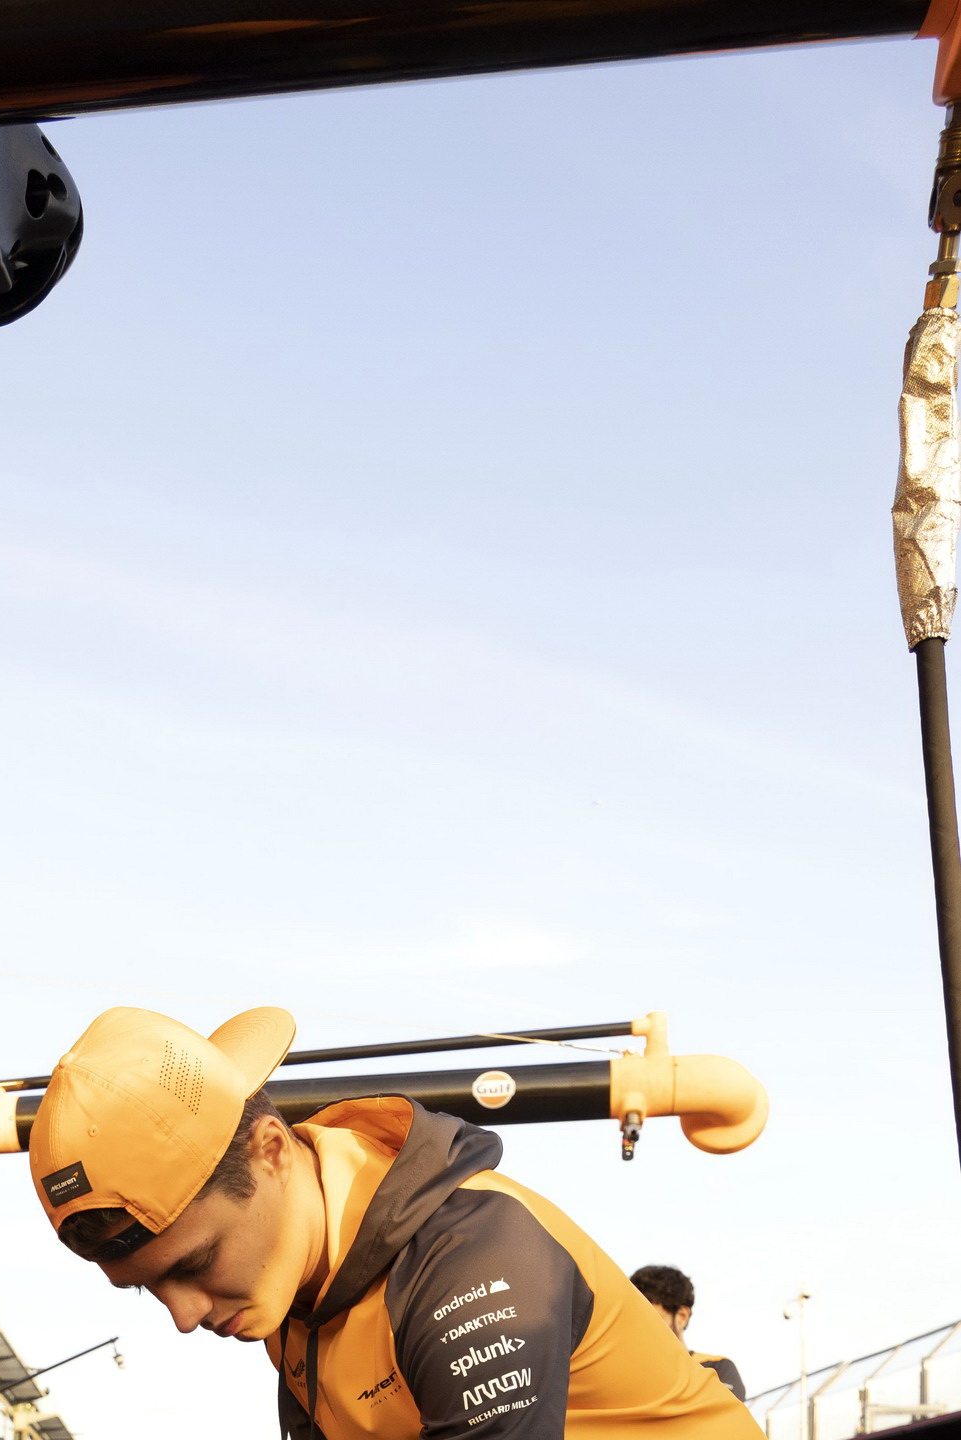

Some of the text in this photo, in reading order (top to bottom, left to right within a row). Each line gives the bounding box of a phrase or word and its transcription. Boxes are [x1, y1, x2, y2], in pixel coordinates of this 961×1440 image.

[476, 1083, 510, 1094] Gulf
[50, 1176, 77, 1193] McLaren
[433, 1283, 487, 1321] android
[449, 1306, 518, 1340] DARKTRACE
[467, 1395, 538, 1426] RICHARD MILLE
